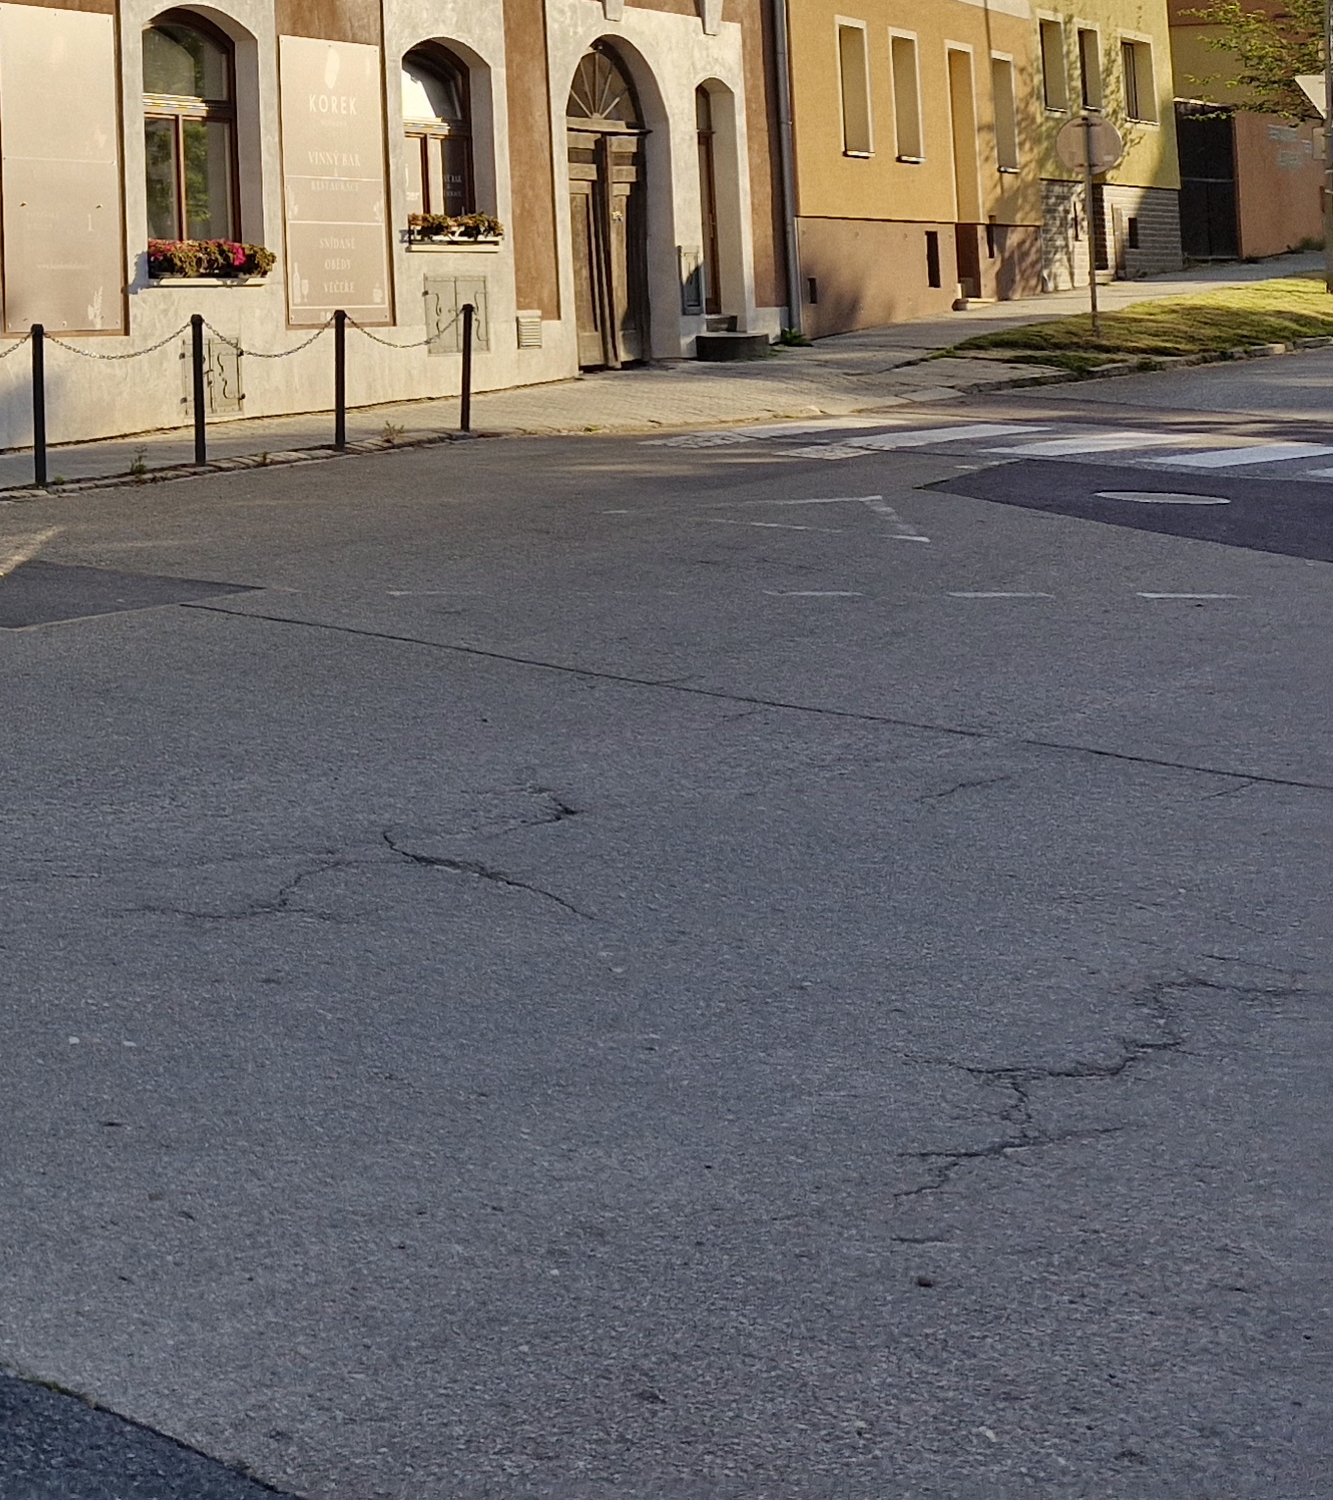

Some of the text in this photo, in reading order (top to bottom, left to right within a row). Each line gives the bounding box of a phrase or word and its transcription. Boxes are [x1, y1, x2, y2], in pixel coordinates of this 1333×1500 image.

[309, 94, 357, 115] KOREK
[308, 150, 361, 167] VINNÝ BAR
[320, 235, 356, 249] SNÍDANĚ
[324, 257, 351, 270] OBĚDY
[323, 279, 355, 293] VEČEŘE
